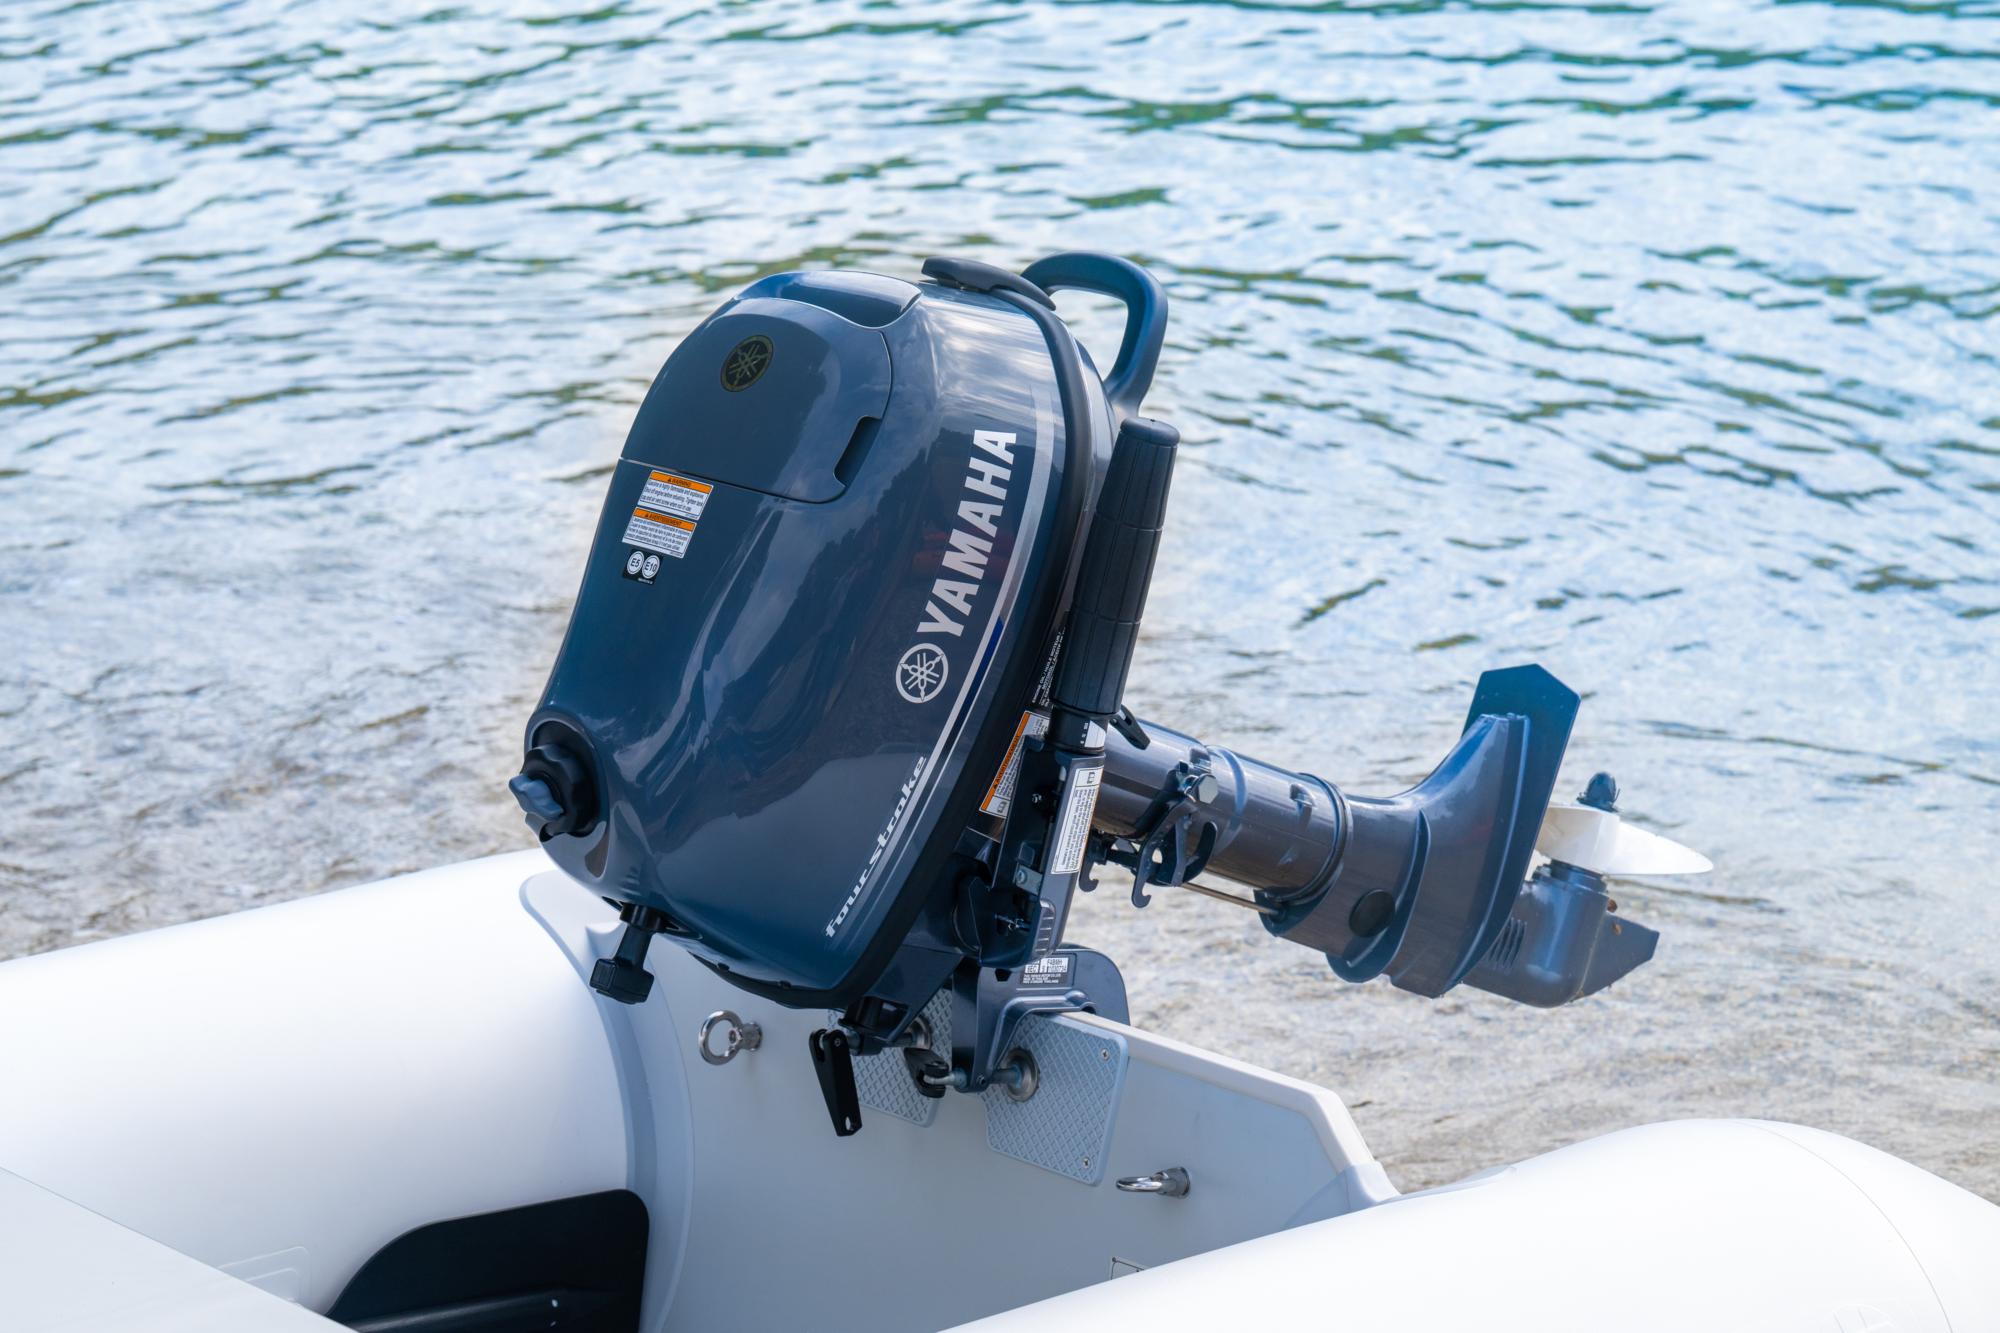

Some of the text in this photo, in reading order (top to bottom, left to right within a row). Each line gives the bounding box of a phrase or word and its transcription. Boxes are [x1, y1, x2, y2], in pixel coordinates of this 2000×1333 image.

[630, 557, 658, 572] E5 E10
[916, 429, 1017, 637] YAMAHA
